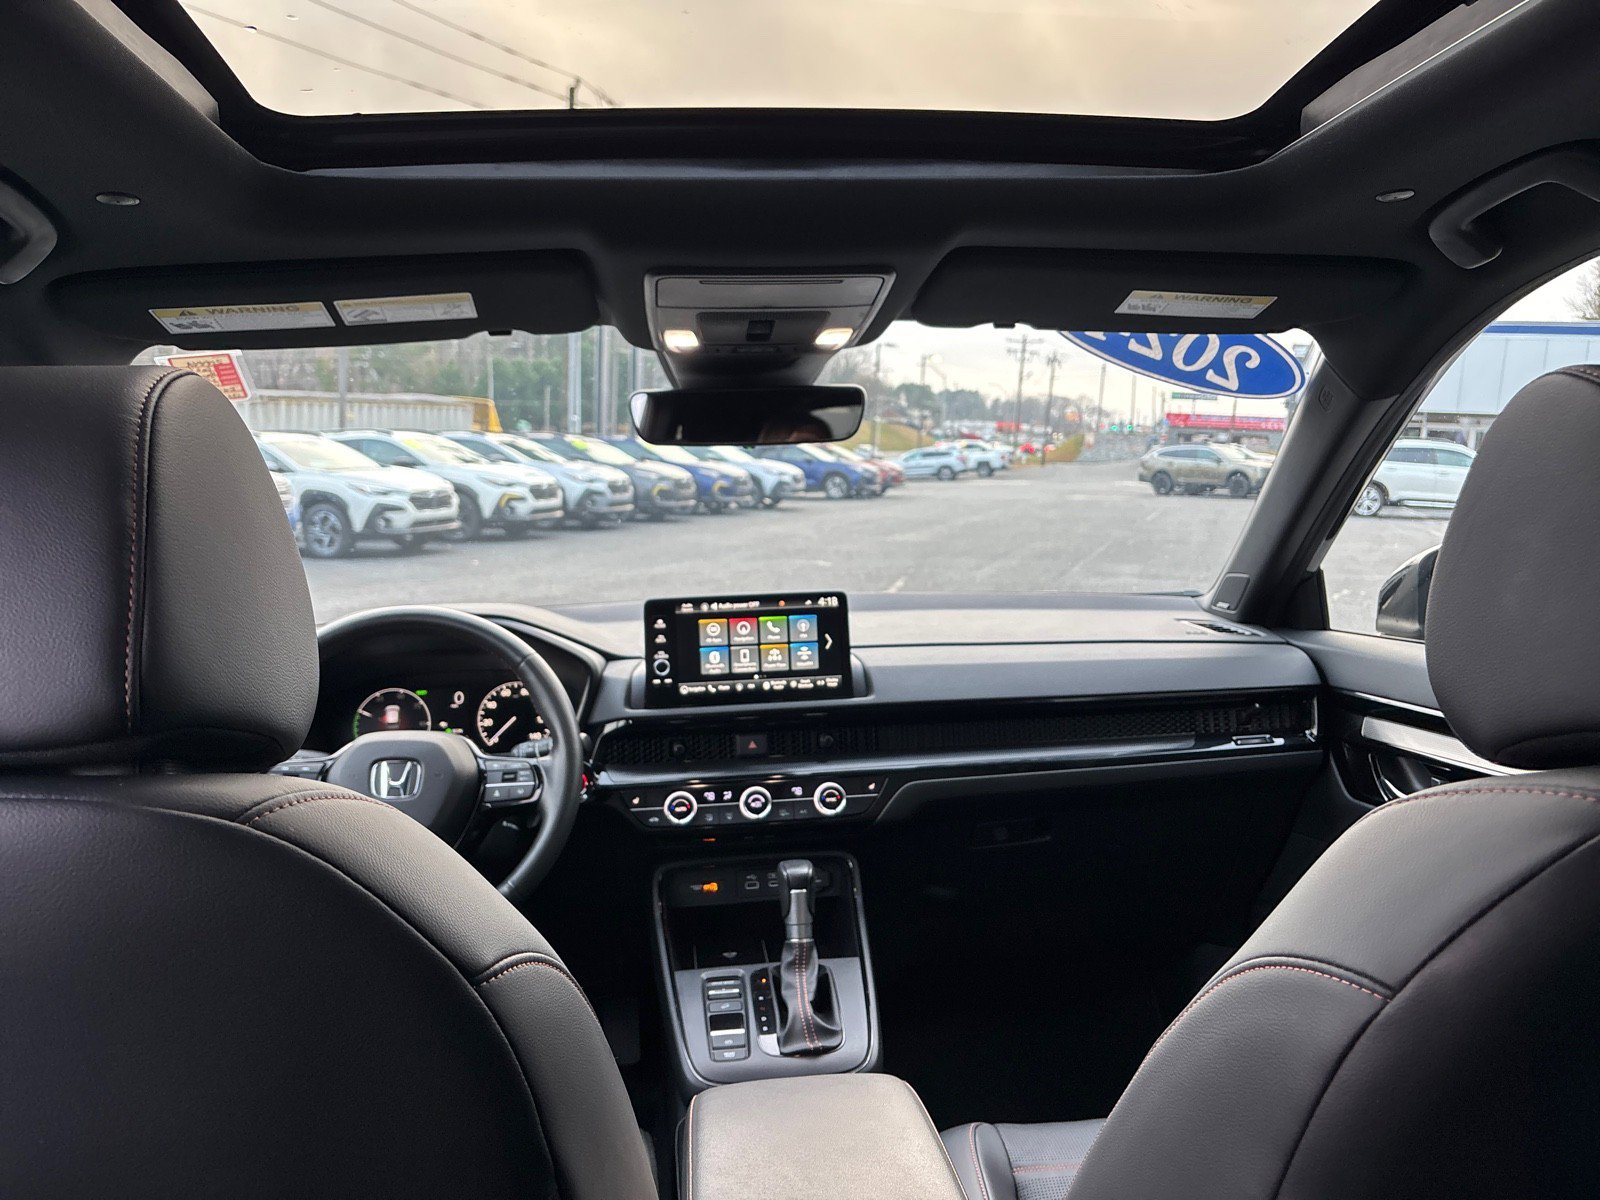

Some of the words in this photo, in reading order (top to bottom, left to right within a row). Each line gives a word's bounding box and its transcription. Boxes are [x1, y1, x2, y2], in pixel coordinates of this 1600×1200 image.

[1174, 293, 1253, 305] WARNING
[204, 303, 301, 317] WARNING
[453, 690, 465, 705] 0
